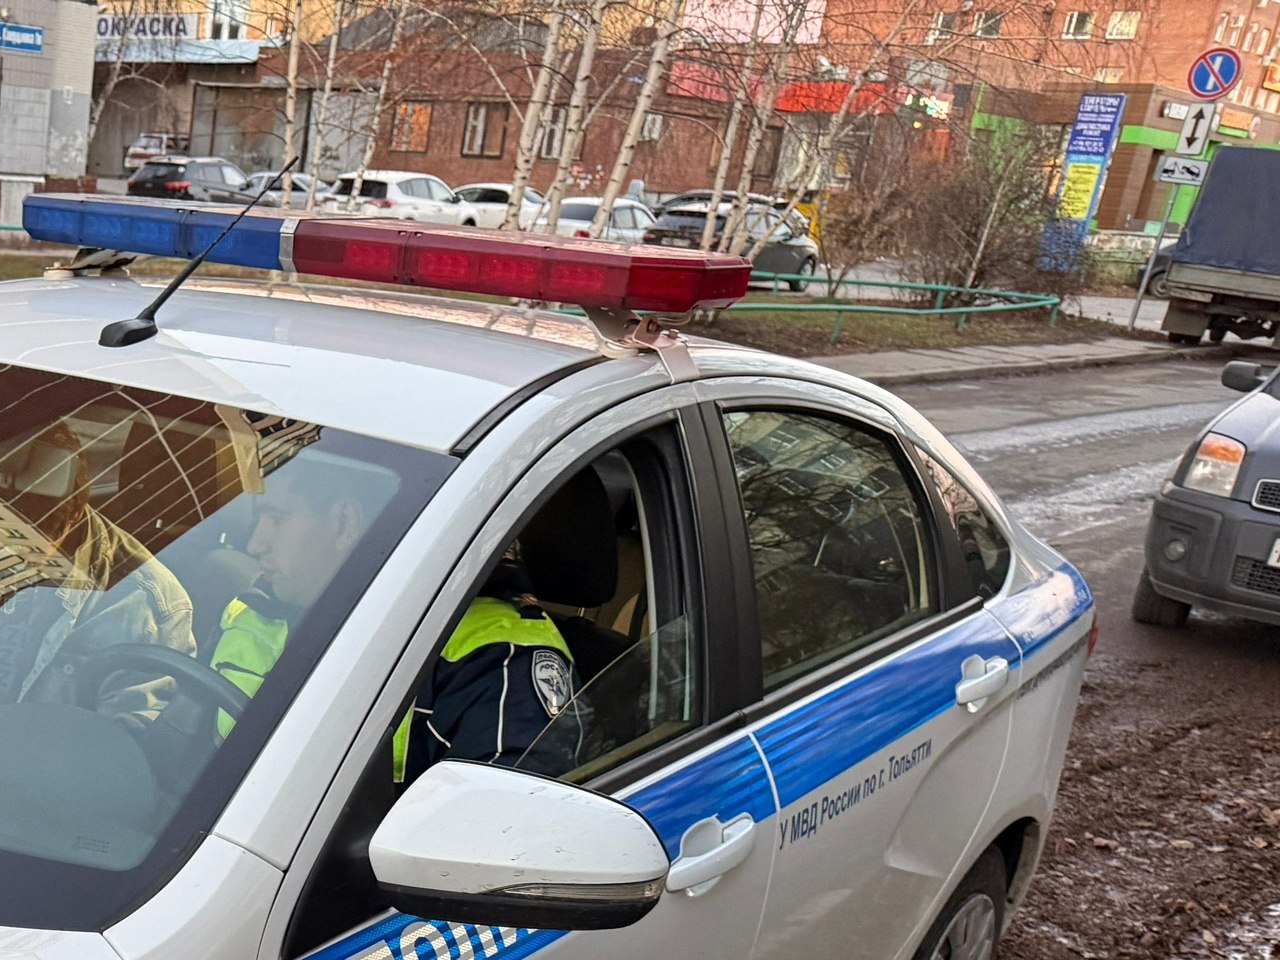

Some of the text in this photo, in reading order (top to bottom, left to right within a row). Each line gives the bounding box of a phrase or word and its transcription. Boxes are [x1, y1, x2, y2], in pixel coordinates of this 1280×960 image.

[779, 739, 932, 851] У МВД России по г. Тольятти
